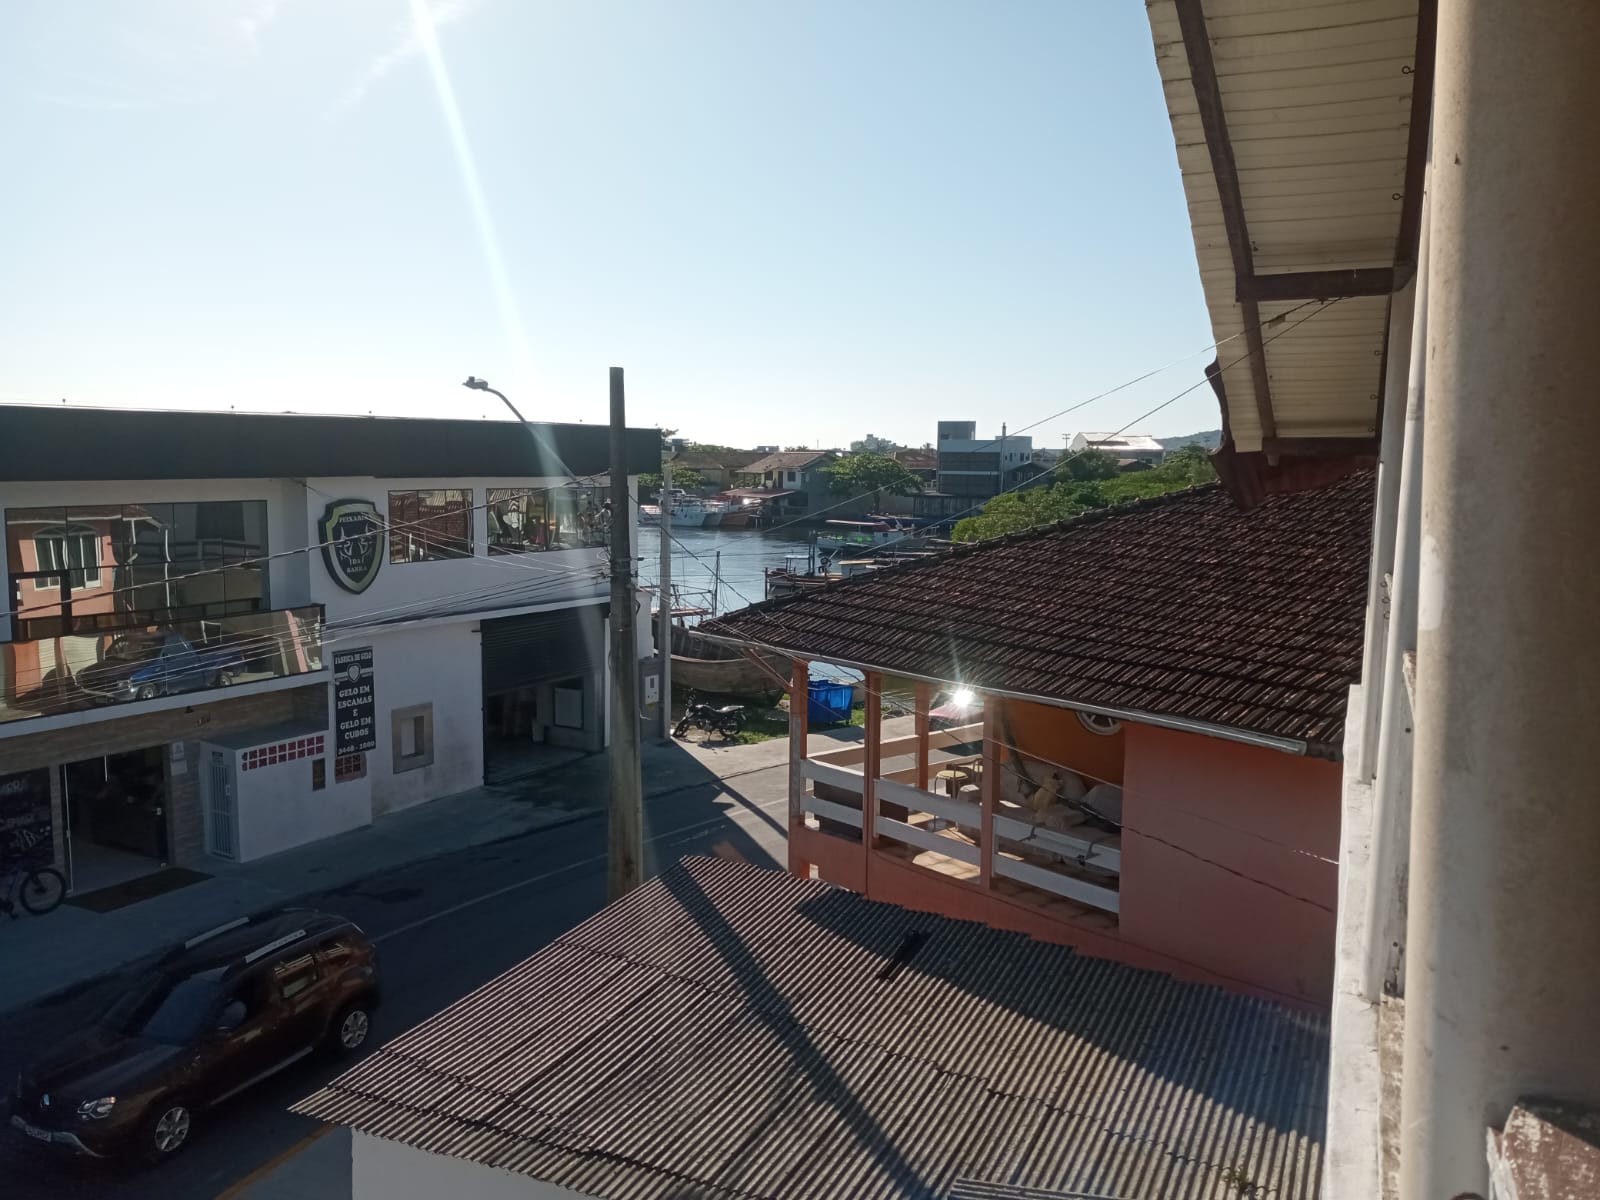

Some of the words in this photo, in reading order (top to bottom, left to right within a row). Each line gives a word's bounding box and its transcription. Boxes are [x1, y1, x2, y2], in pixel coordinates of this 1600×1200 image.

[339, 688, 358, 697] GELO
[360, 685, 370, 693] EM
[337, 696, 372, 709] ESCAMAS
[340, 720, 359, 729] GELO
[361, 716, 371, 725] EM
[344, 728, 369, 739] CUBOS
